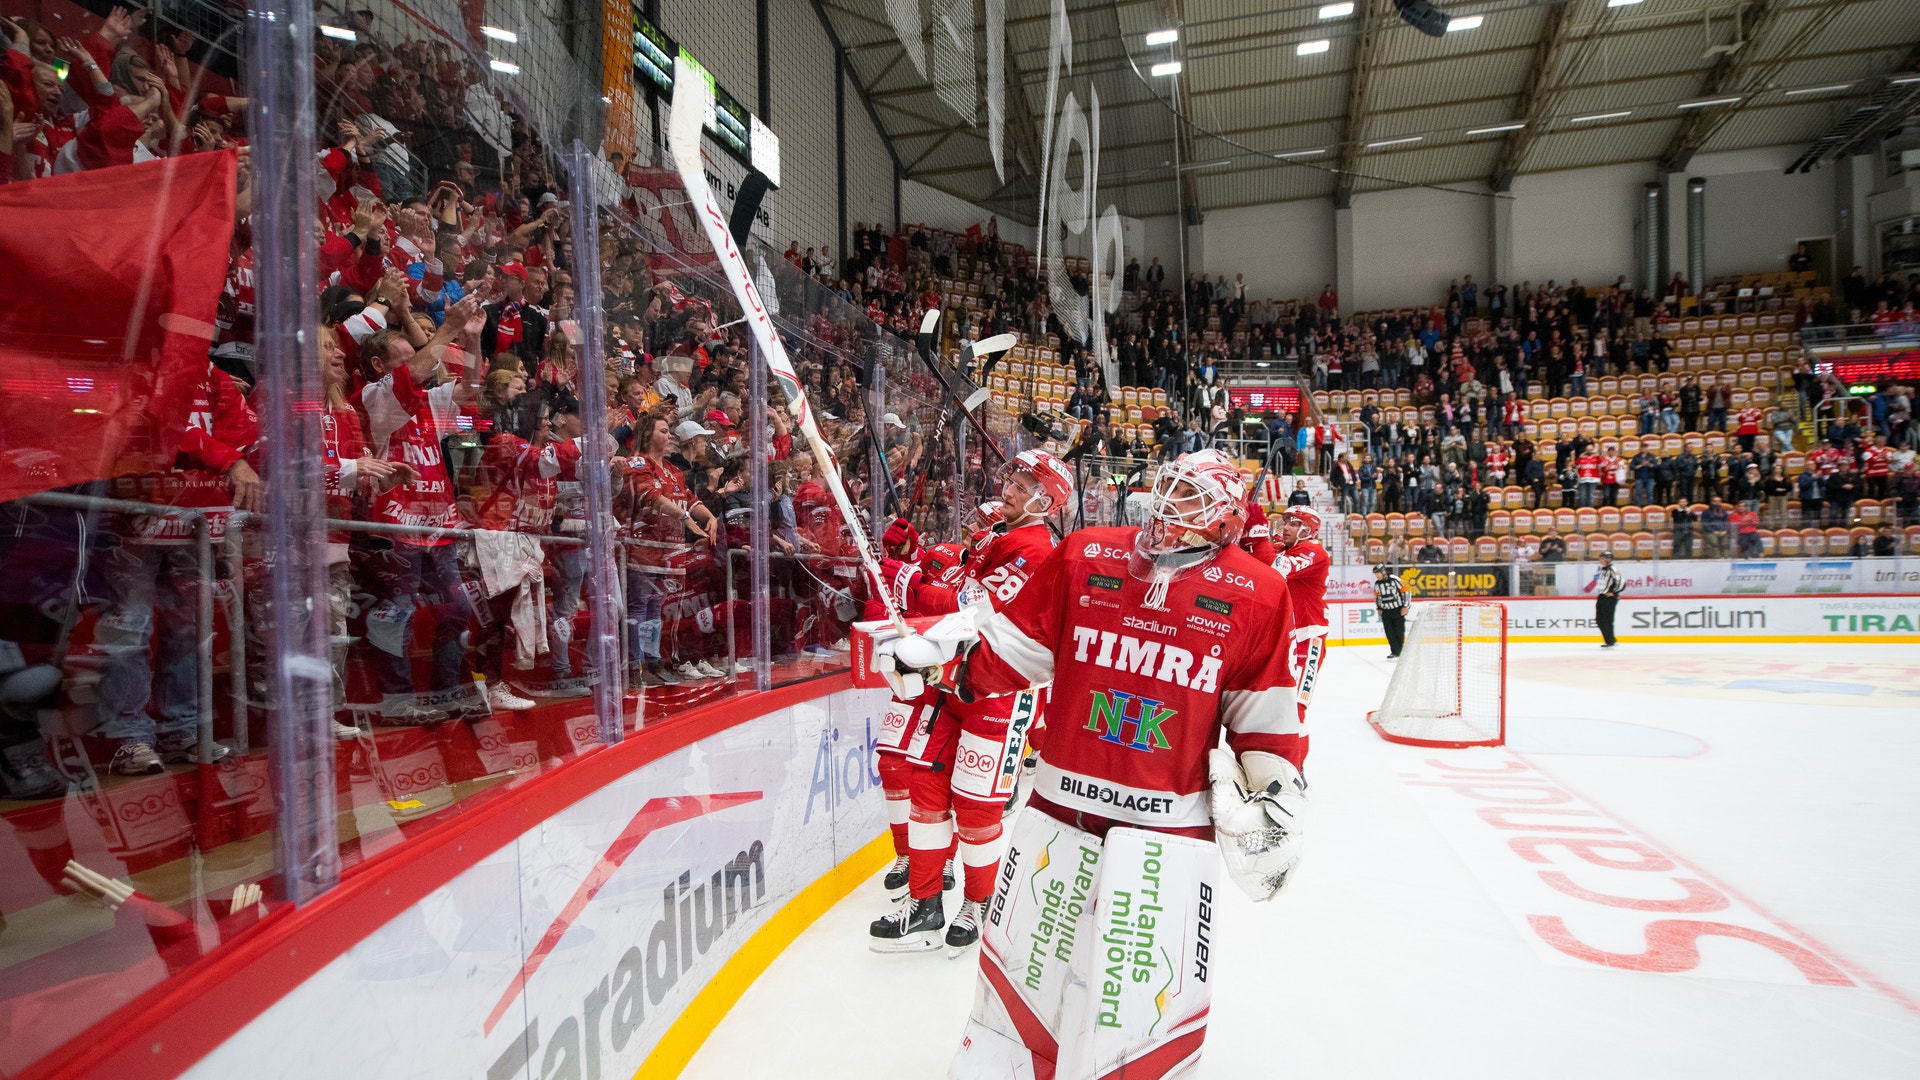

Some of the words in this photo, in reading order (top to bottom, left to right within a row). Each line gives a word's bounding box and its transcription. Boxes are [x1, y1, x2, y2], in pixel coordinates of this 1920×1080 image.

[1103, 547, 1132, 561] SCA
[981, 566, 1024, 602] 28
[1225, 572, 1255, 592] SCA
[1122, 615, 1178, 637] stadium
[1186, 615, 1231, 633] JOWIC
[1631, 606, 1767, 630] stadium
[1822, 614, 1920, 632] TIRA
[1073, 625, 1224, 695] TIMRÅ
[1302, 644, 1320, 693] PEAB
[1002, 692, 1035, 777] PEAB
[1060, 775, 1174, 814] BILBOLAGET
[989, 846, 1021, 927] BAUER
[1131, 841, 1163, 983] norrlands
[1025, 878, 1065, 991] norrlands
[1194, 882, 1213, 983] BAUER
